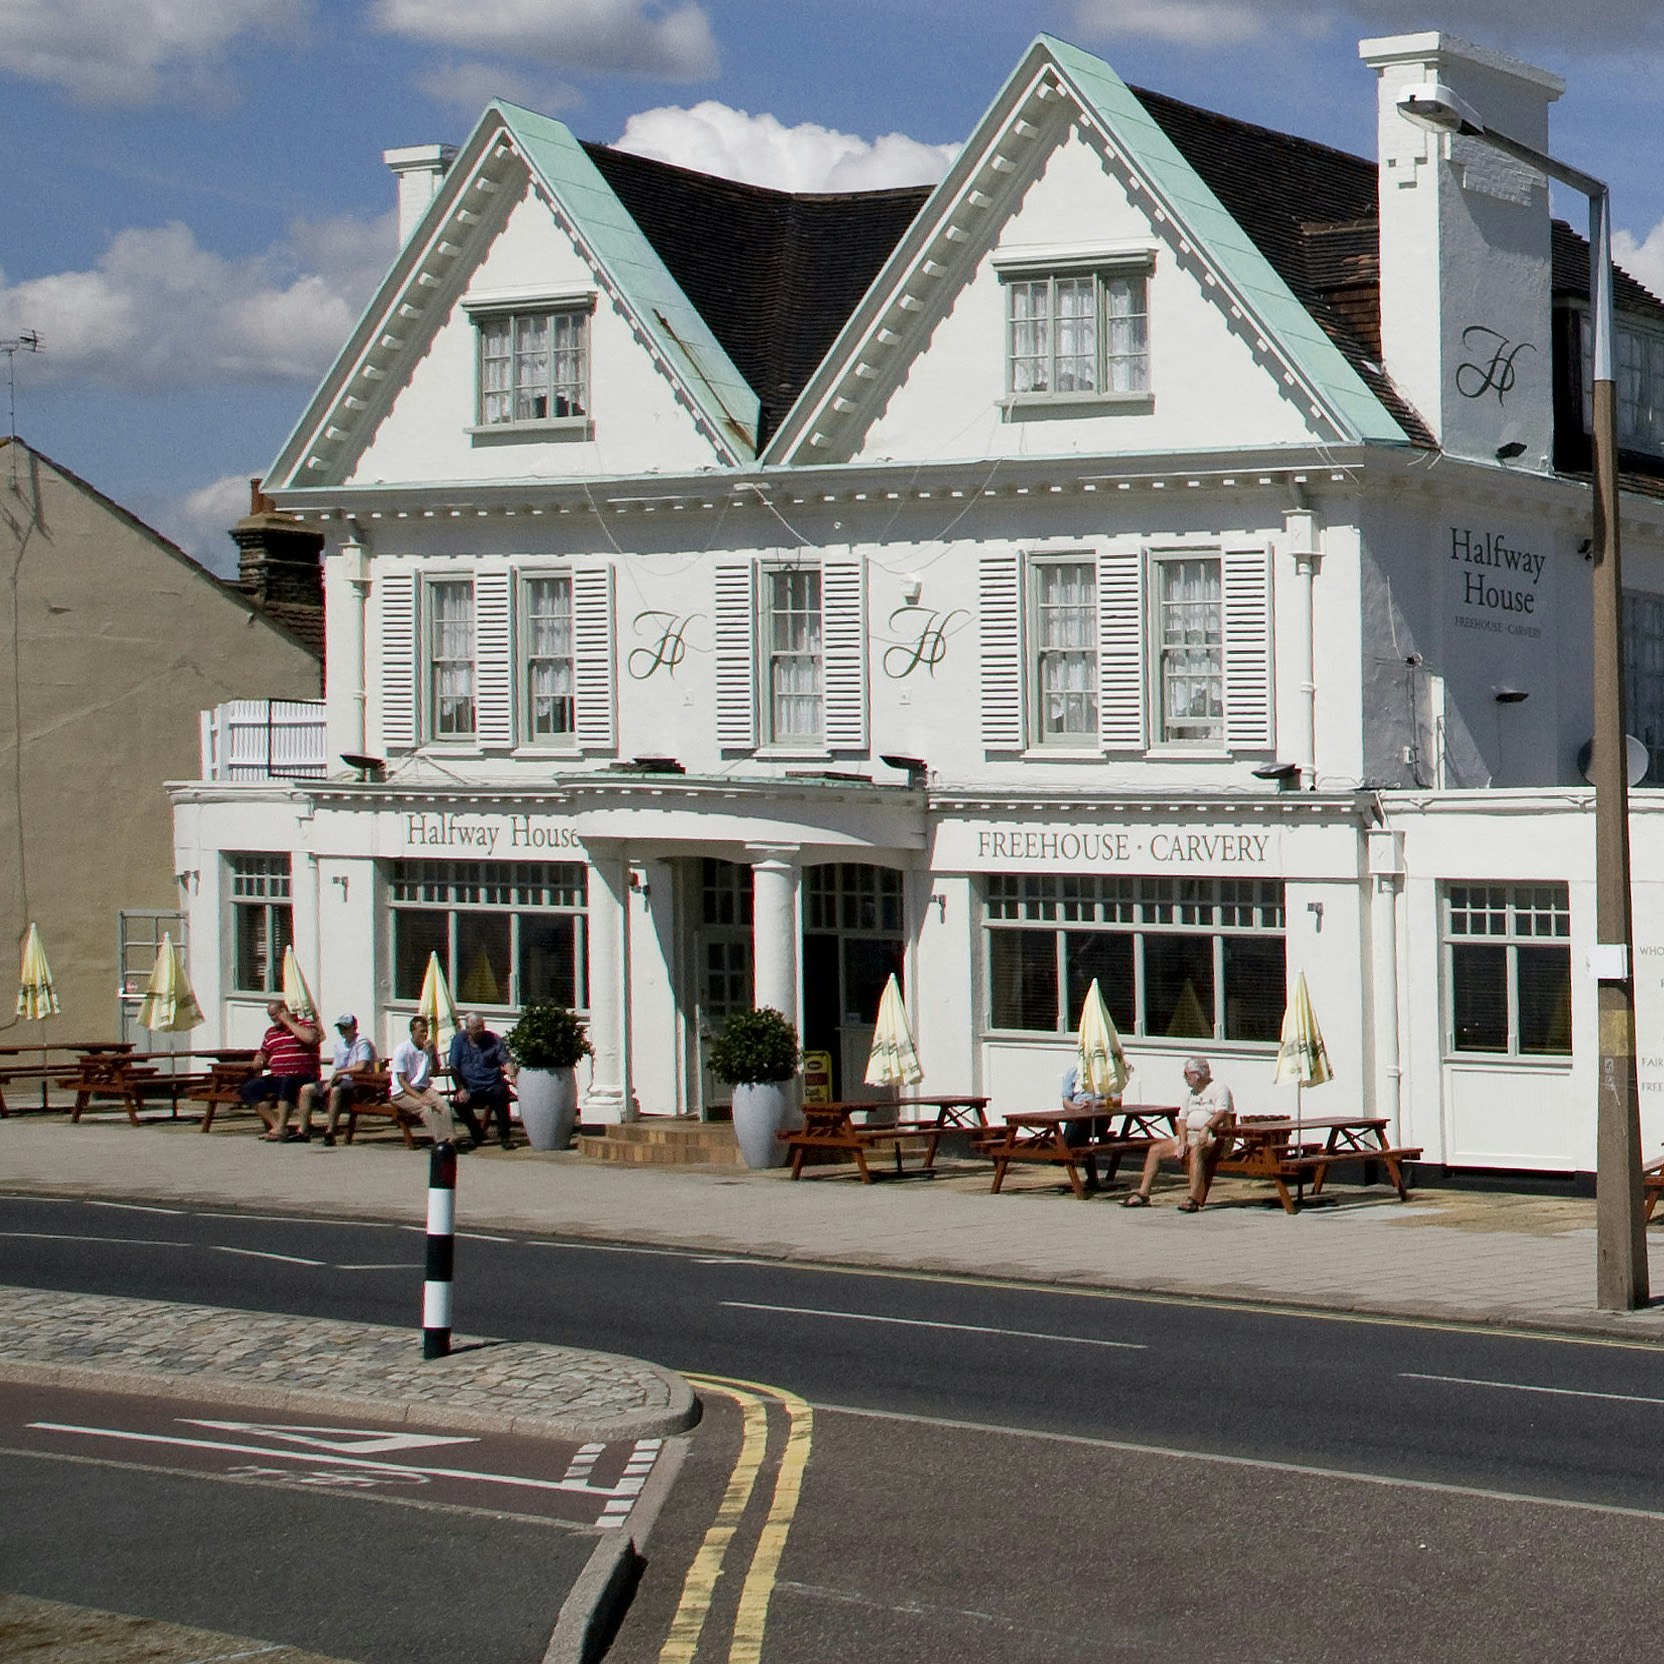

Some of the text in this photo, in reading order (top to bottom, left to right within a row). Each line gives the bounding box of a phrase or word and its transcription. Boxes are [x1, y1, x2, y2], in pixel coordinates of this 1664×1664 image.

[1449, 527, 1546, 585] Halfway
[1463, 570, 1535, 614] House
[407, 813, 581, 856] Halfway House
[978, 831, 1270, 863] FREEHOUSE CARVERY
[1641, 1057, 1664, 1068] FAIR
[1641, 1081, 1664, 1092] FREE
